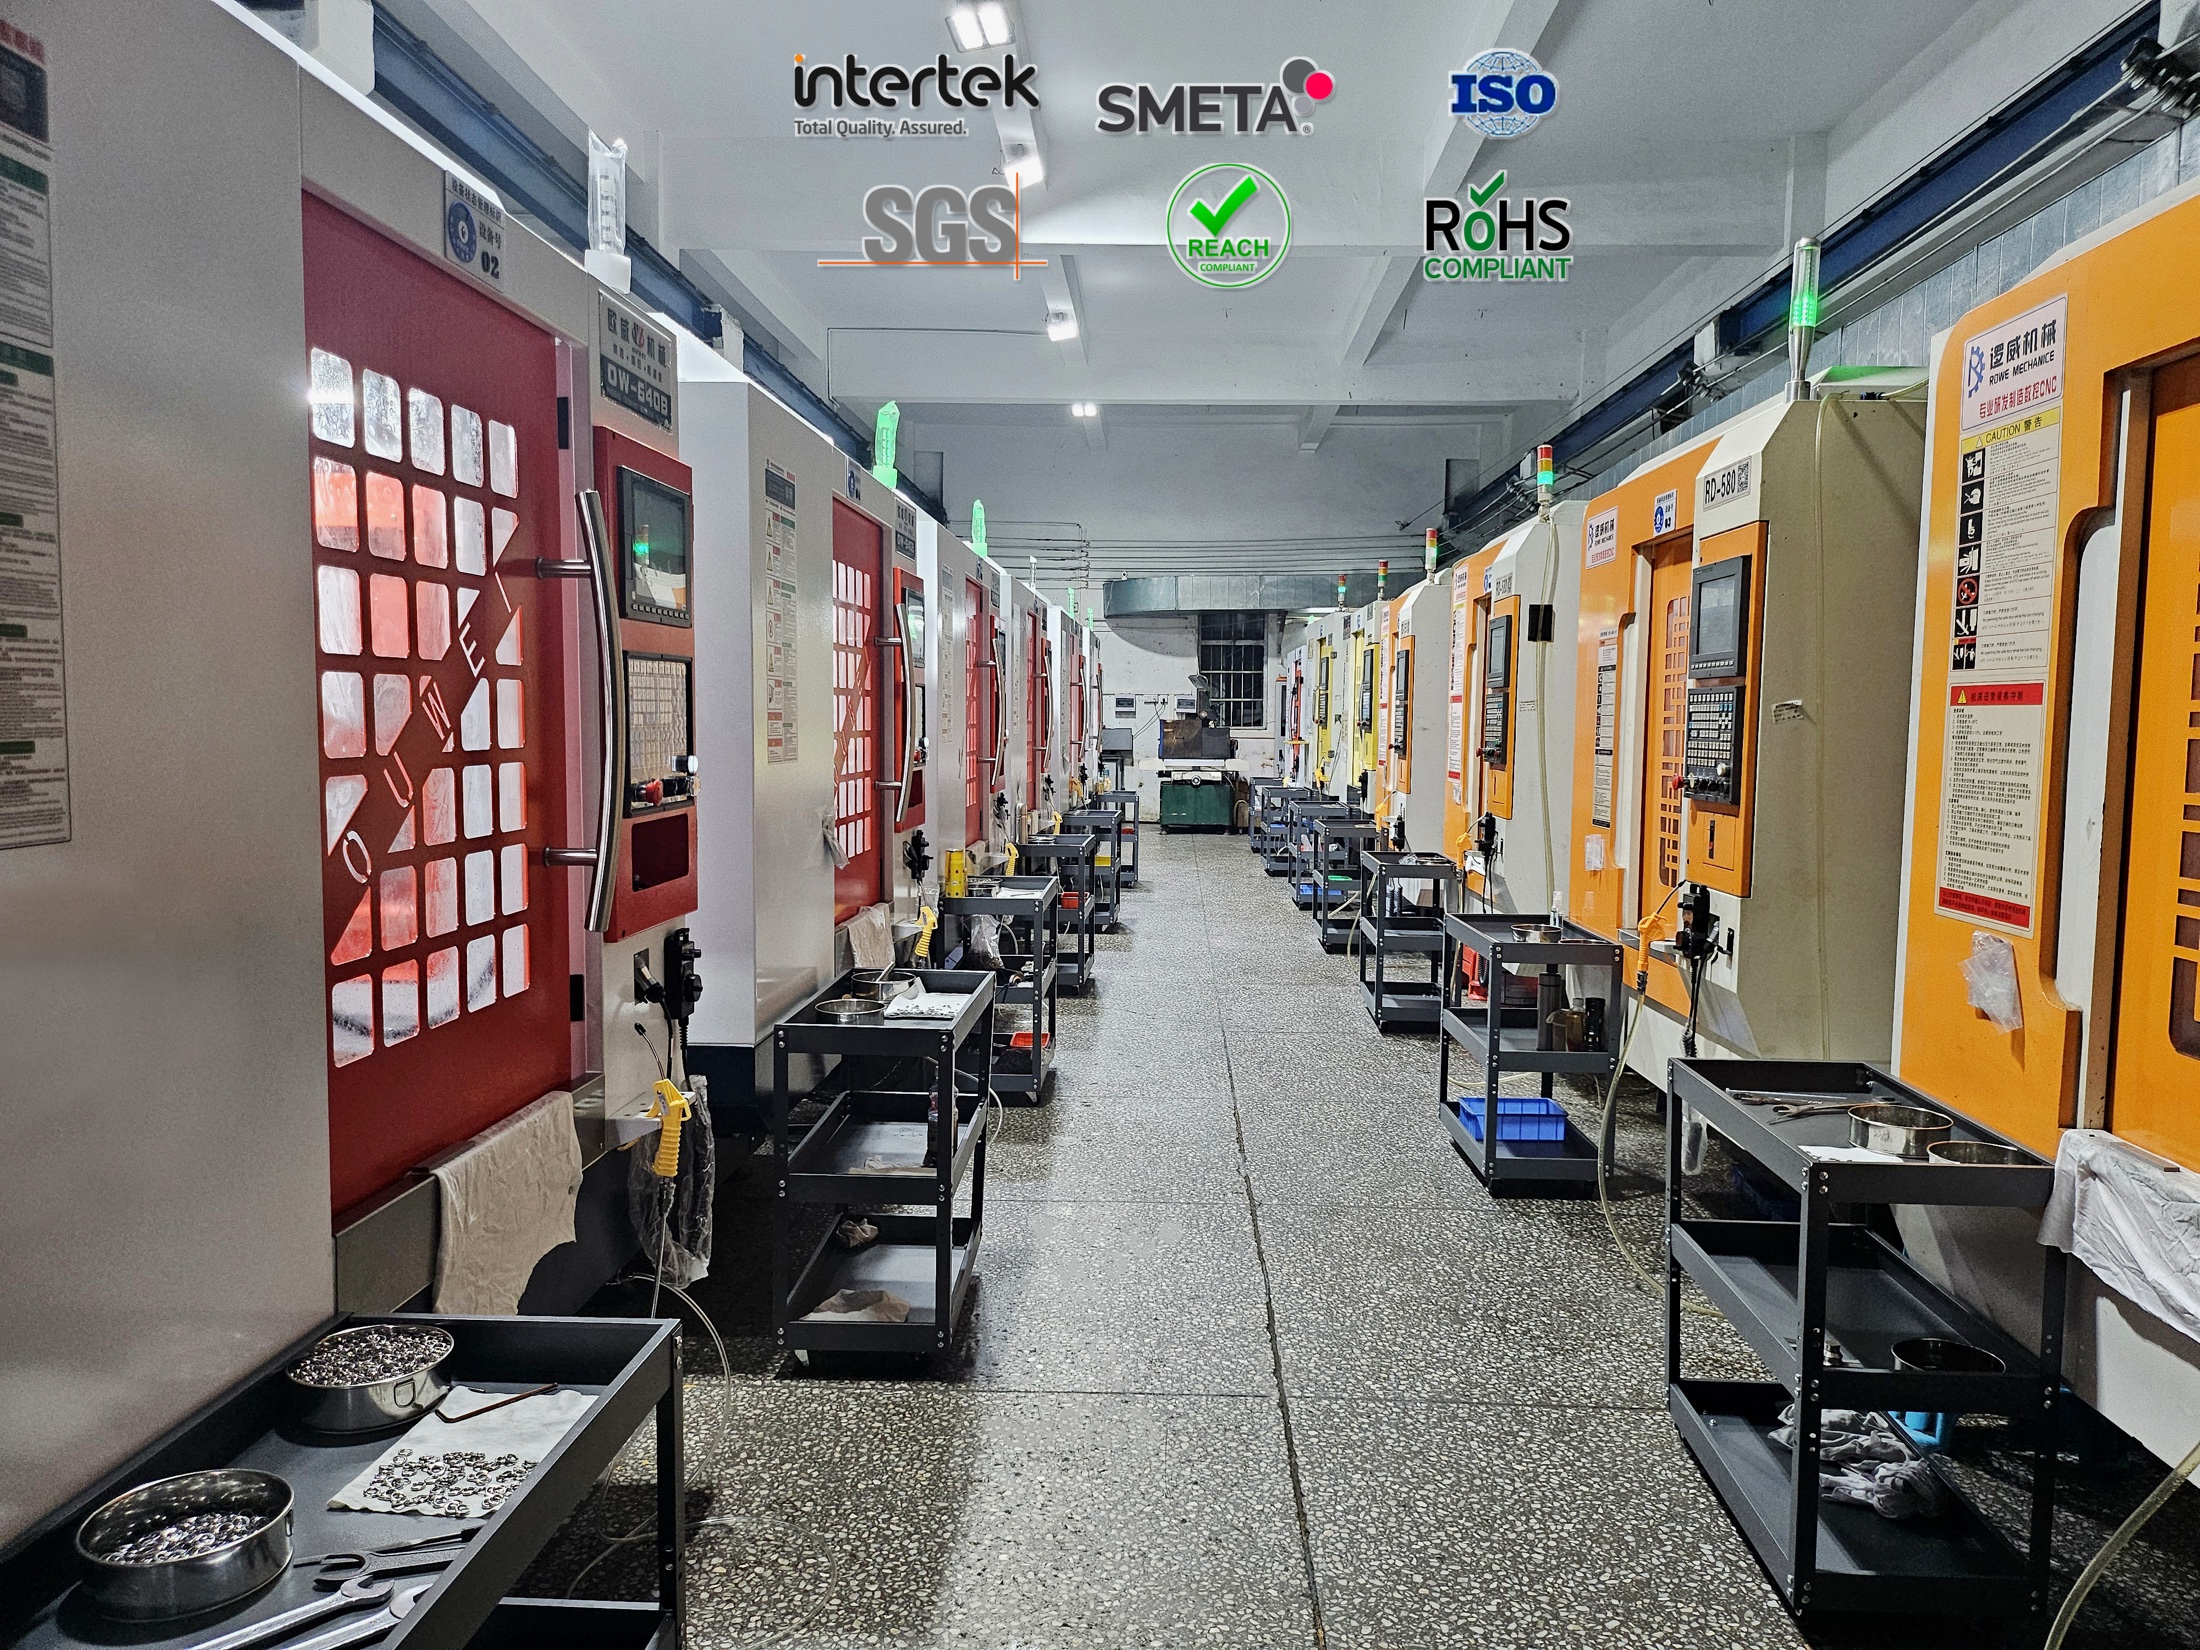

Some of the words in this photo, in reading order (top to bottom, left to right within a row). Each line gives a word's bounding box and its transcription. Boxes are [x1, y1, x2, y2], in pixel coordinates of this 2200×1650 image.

[481, 250, 500, 280] 02
[1989, 319, 2057, 371] 逻威机械
[1989, 368, 2010, 386] ROWE
[1985, 422, 2021, 445] CAUTION
[1704, 469, 1736, 505] RD-580
